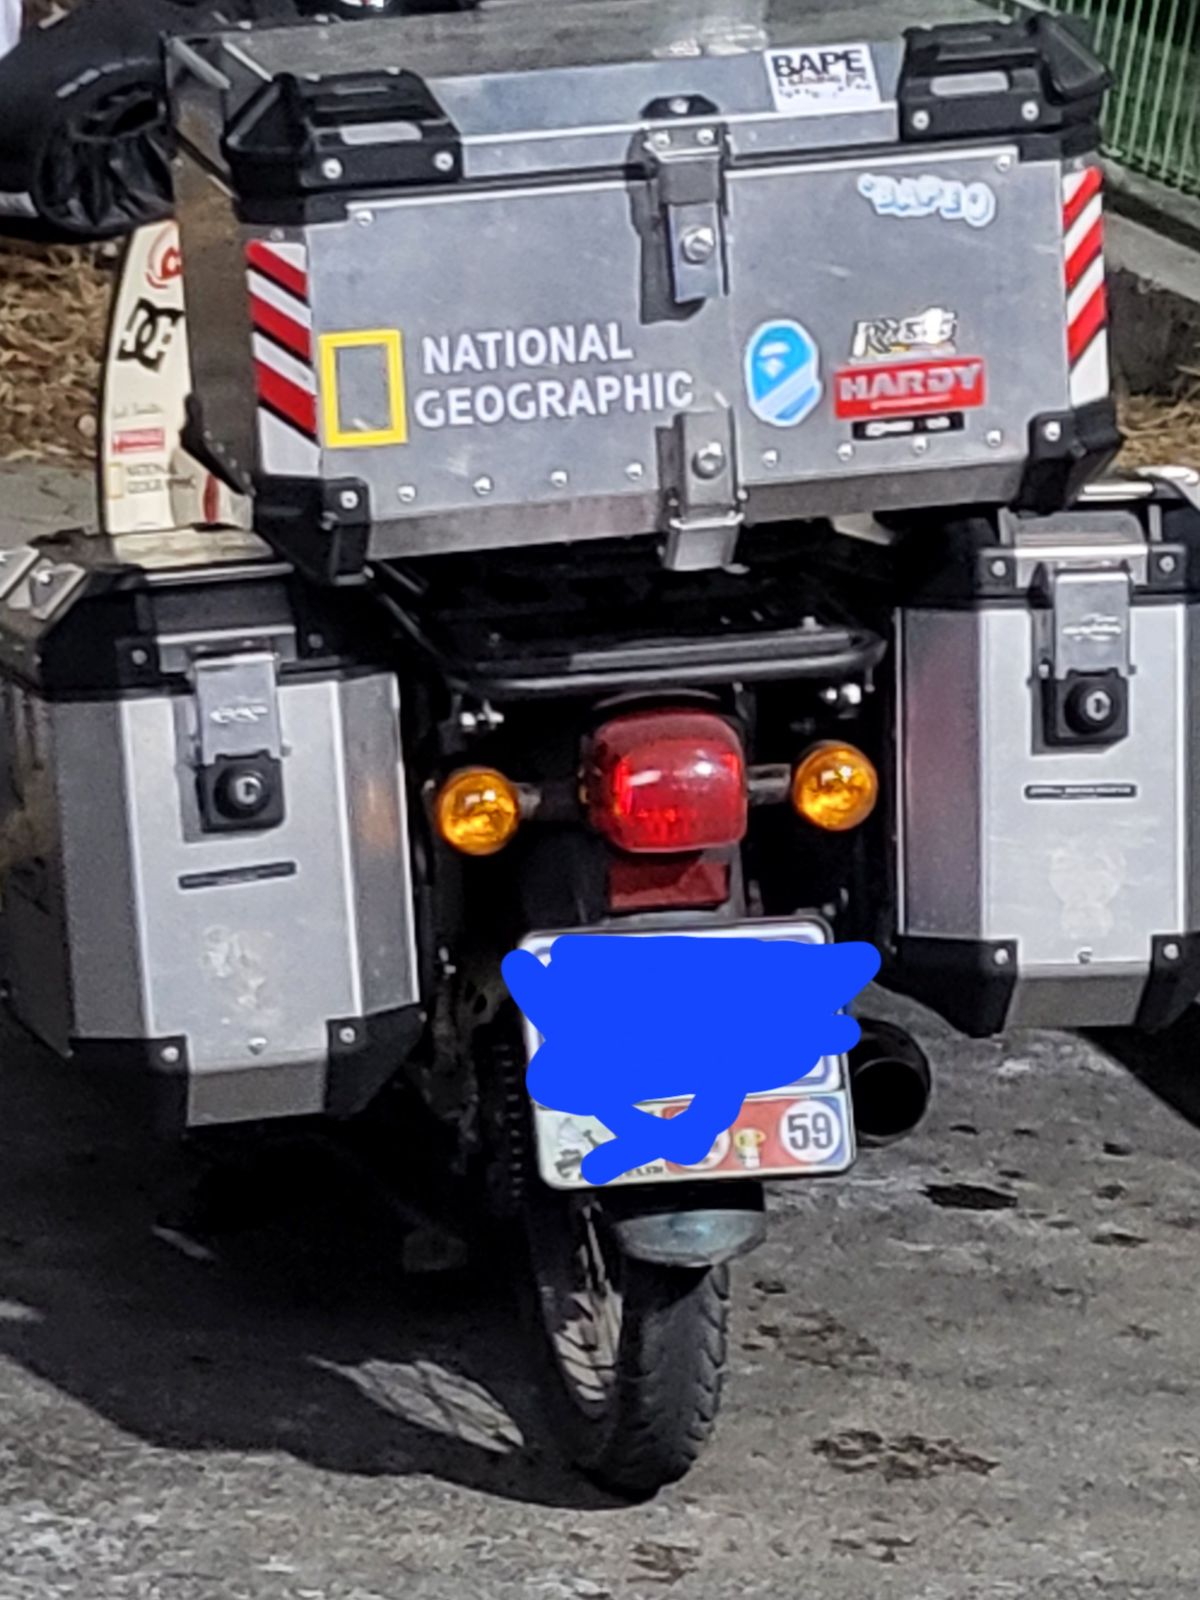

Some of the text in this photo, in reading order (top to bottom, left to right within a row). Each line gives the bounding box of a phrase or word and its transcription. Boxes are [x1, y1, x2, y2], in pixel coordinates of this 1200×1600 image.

[771, 49, 866, 78] BAPE
[421, 321, 634, 375] NATIONAL
[414, 370, 693, 429] GEOGRAPHIC
[839, 364, 983, 402] HARDY
[786, 1111, 833, 1151] 59
